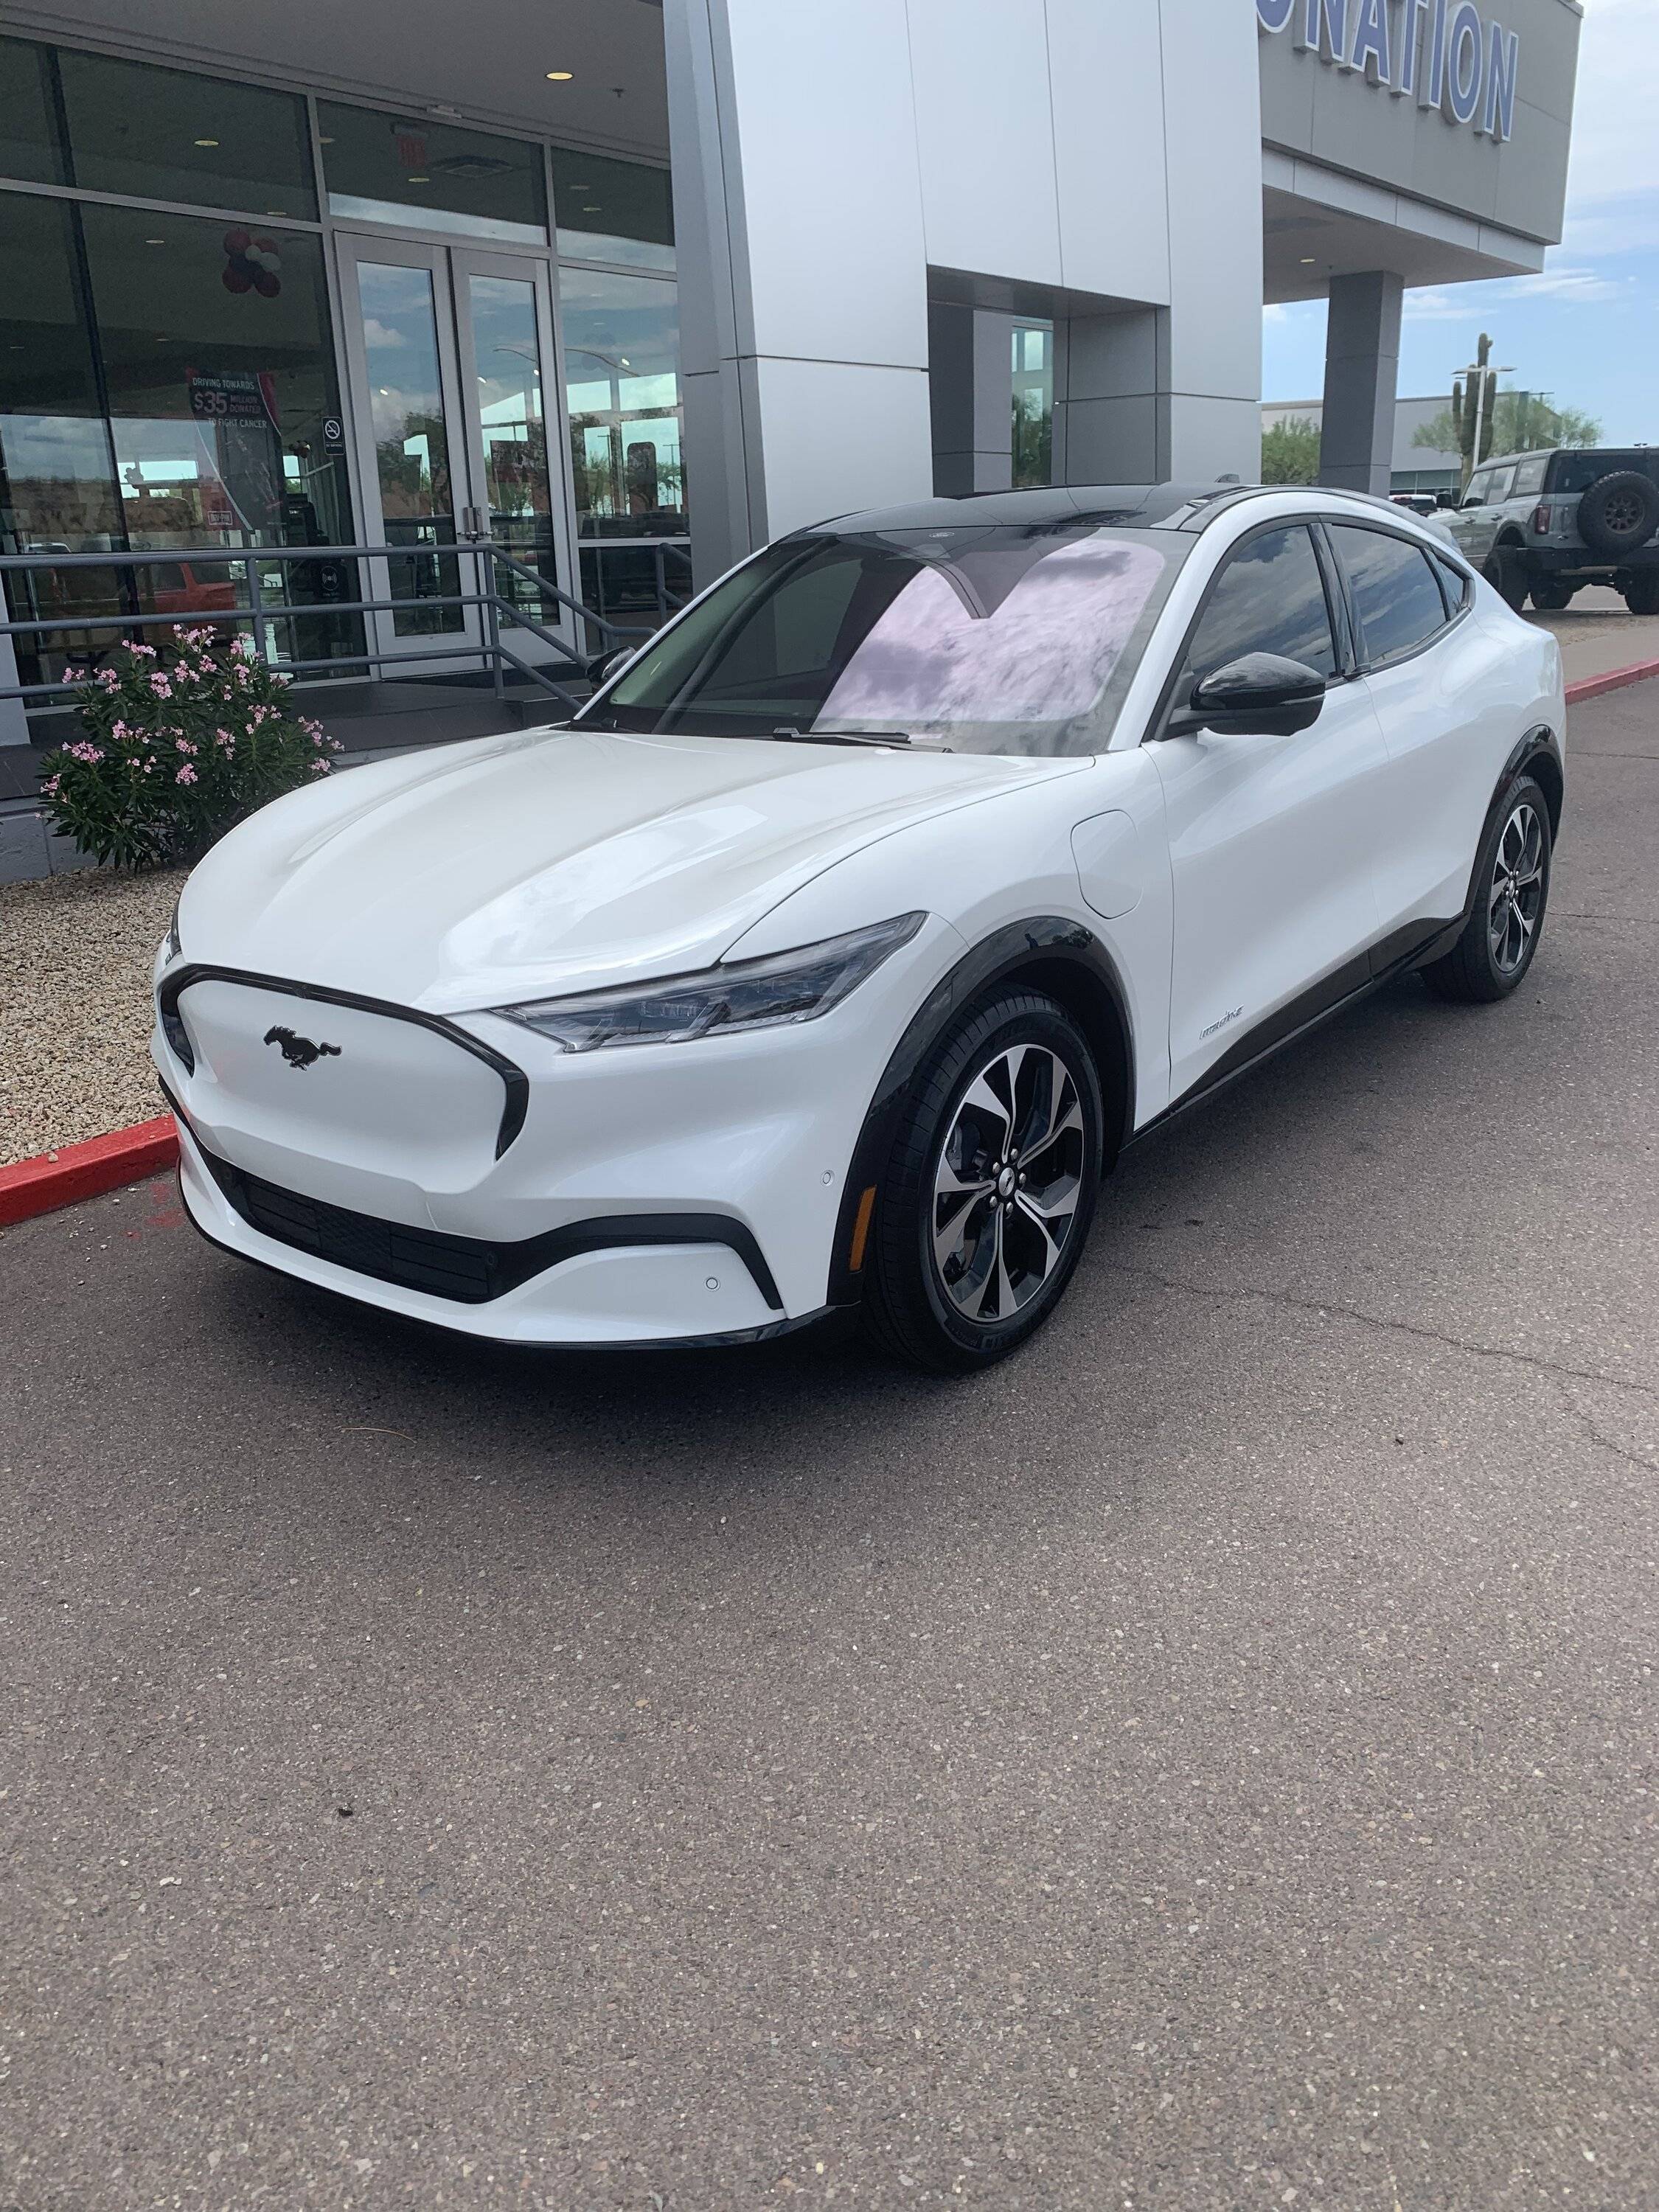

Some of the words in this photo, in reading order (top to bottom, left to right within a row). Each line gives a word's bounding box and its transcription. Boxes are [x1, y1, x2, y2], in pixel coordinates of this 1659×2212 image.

[192, 377, 221, 389] DRIVING
[223, 379, 255, 390] TOWARDS
[194, 391, 227, 414] $35
[218, 418, 238, 427] FIGHT
[240, 420, 267, 428] CANCER
